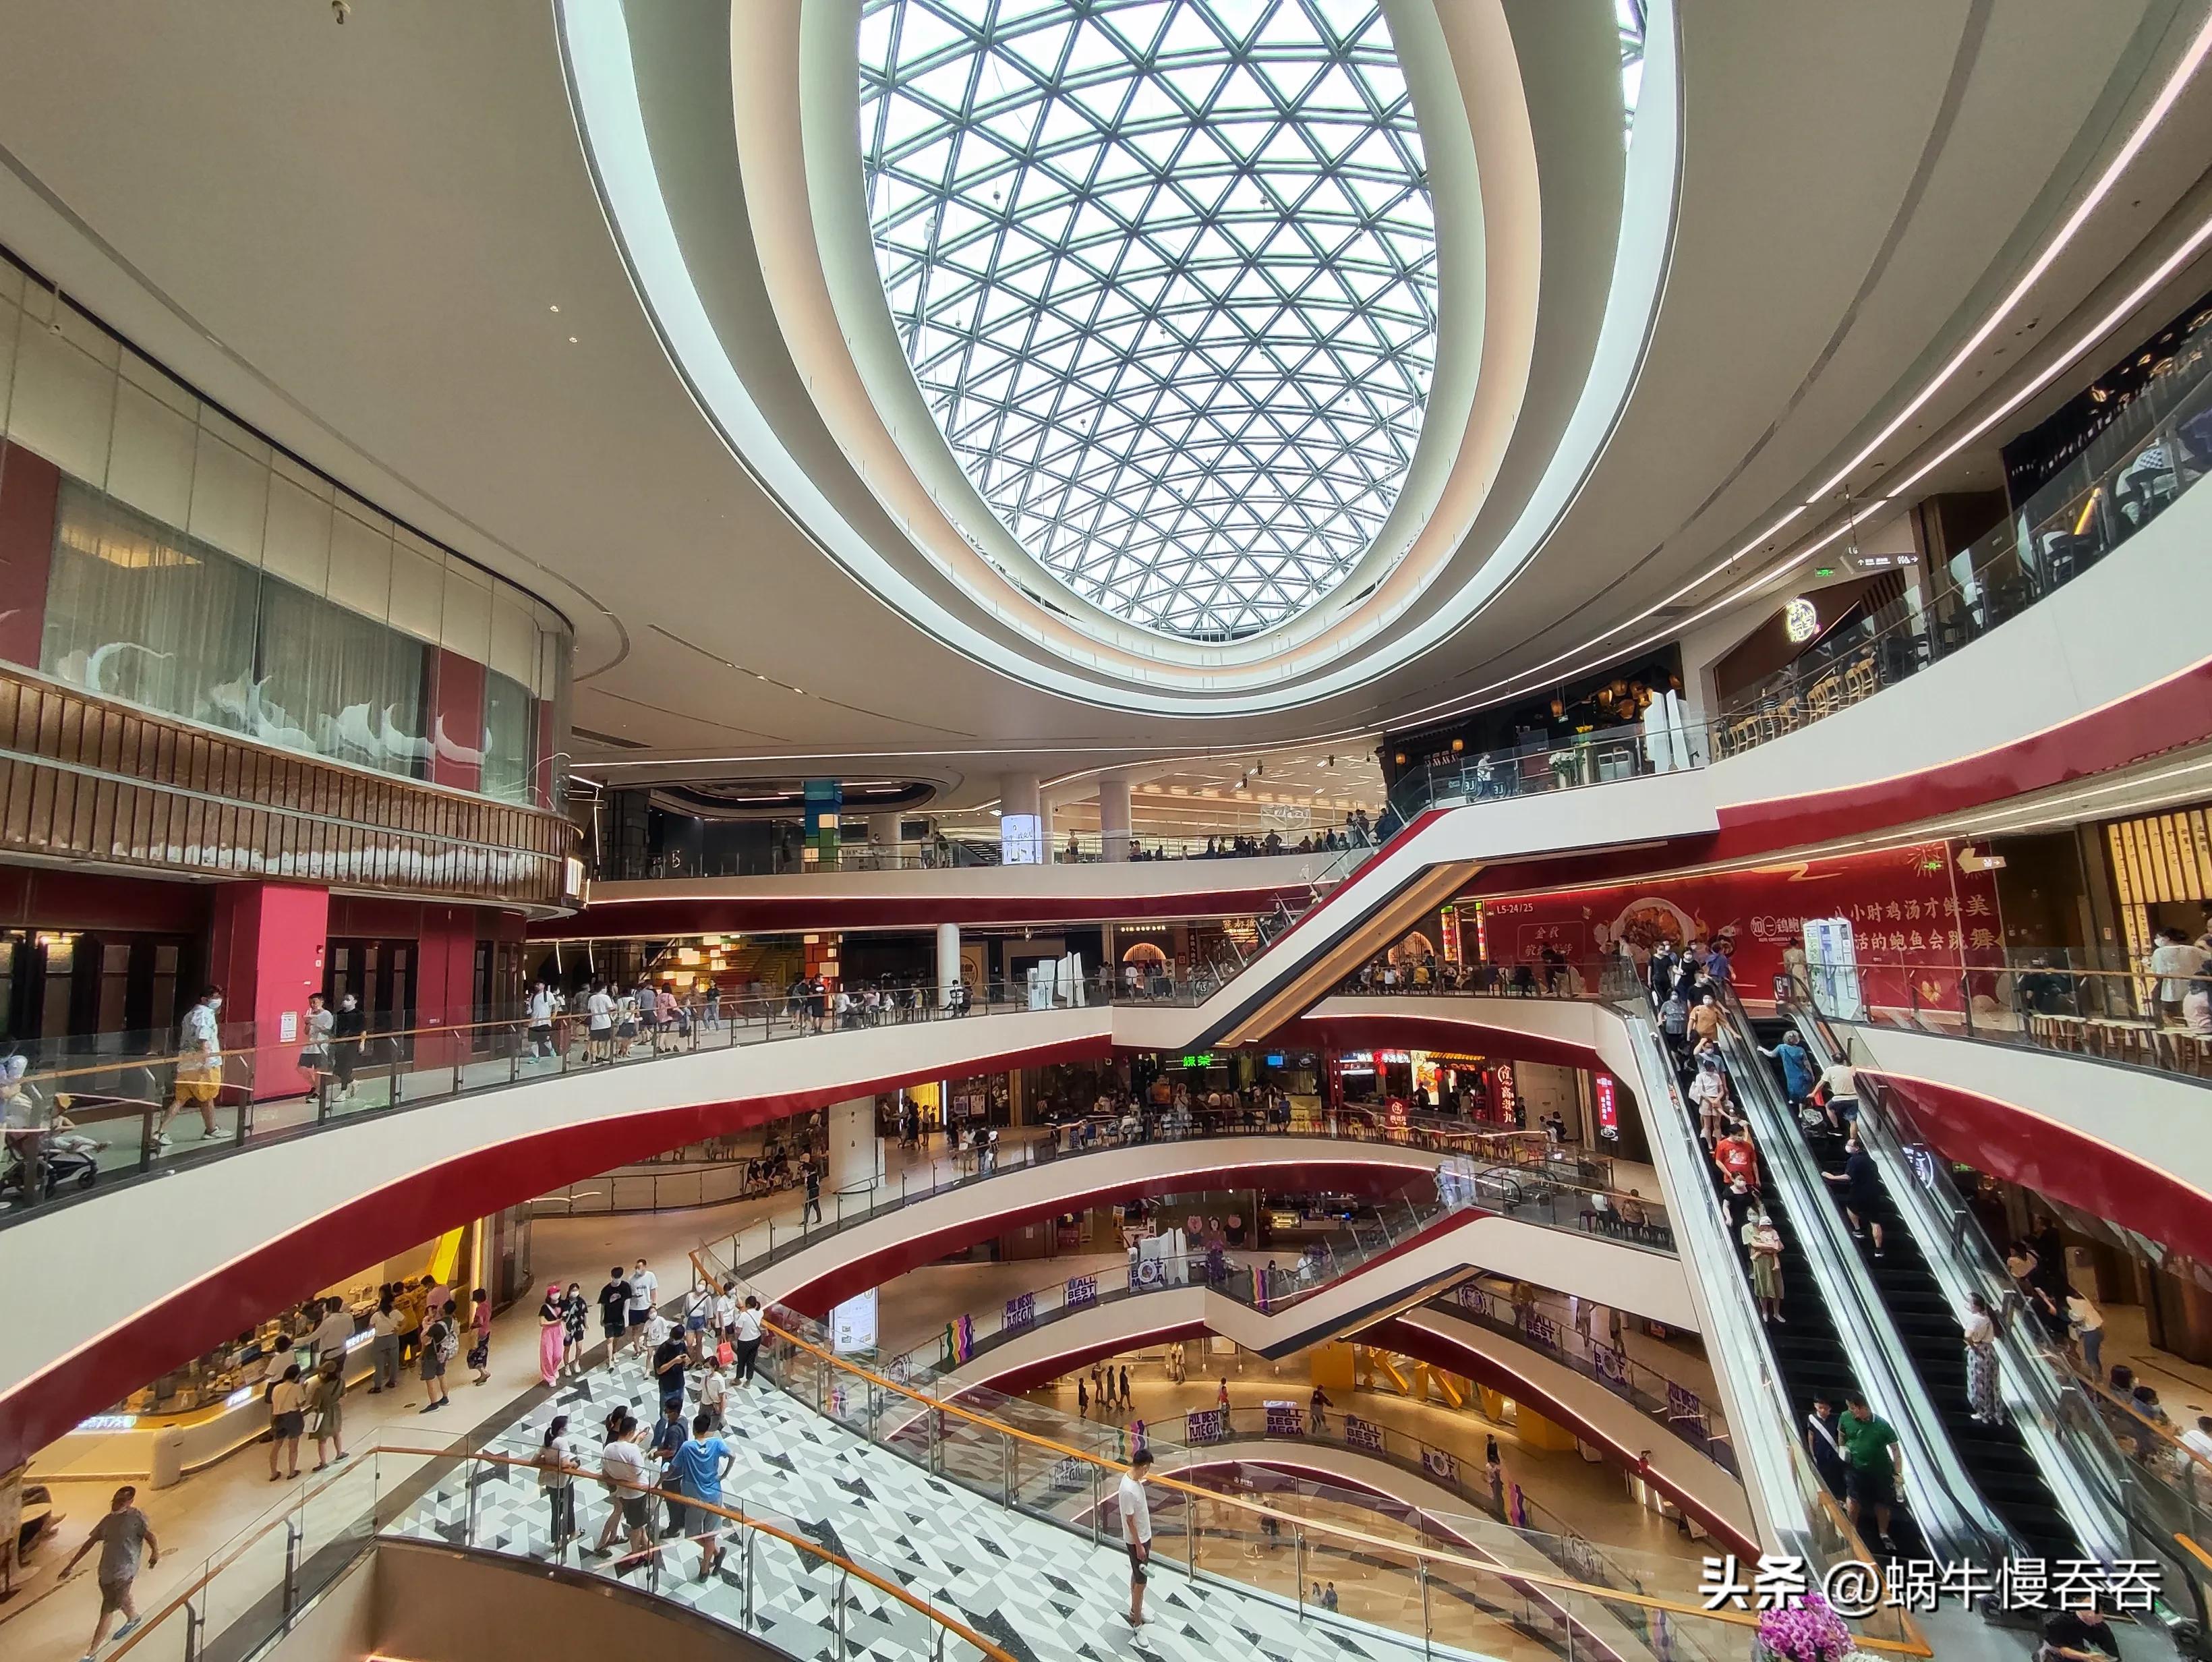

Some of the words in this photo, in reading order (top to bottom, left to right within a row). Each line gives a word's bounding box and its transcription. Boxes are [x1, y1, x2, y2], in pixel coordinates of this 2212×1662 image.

[1496, 902, 1534, 915] L5-24/25
[1132, 1265, 1163, 1279] BT
[1076, 1276, 1097, 1288] ALL
[1068, 1284, 1095, 1299] BEST
[1017, 1292, 1034, 1311] BEST
[1068, 1293, 1097, 1309] MEGA
[1526, 1319, 1555, 1340] BEST
[1536, 1315, 1556, 1333] ALL
[1595, 1352, 1625, 1376] BT
[1188, 1412, 1202, 1426] ALL
[1202, 1410, 1220, 1423] BEST
[1267, 1416, 1302, 1427] BEST
[1189, 1422, 1221, 1439] MEGA
[1267, 1425, 1304, 1436] MEGA
[1346, 1427, 1381, 1443] BEST
[1358, 1422, 1382, 1436] ALL
[1347, 1437, 1384, 1454] MEGA
[1423, 1452, 1455, 1474] BT
